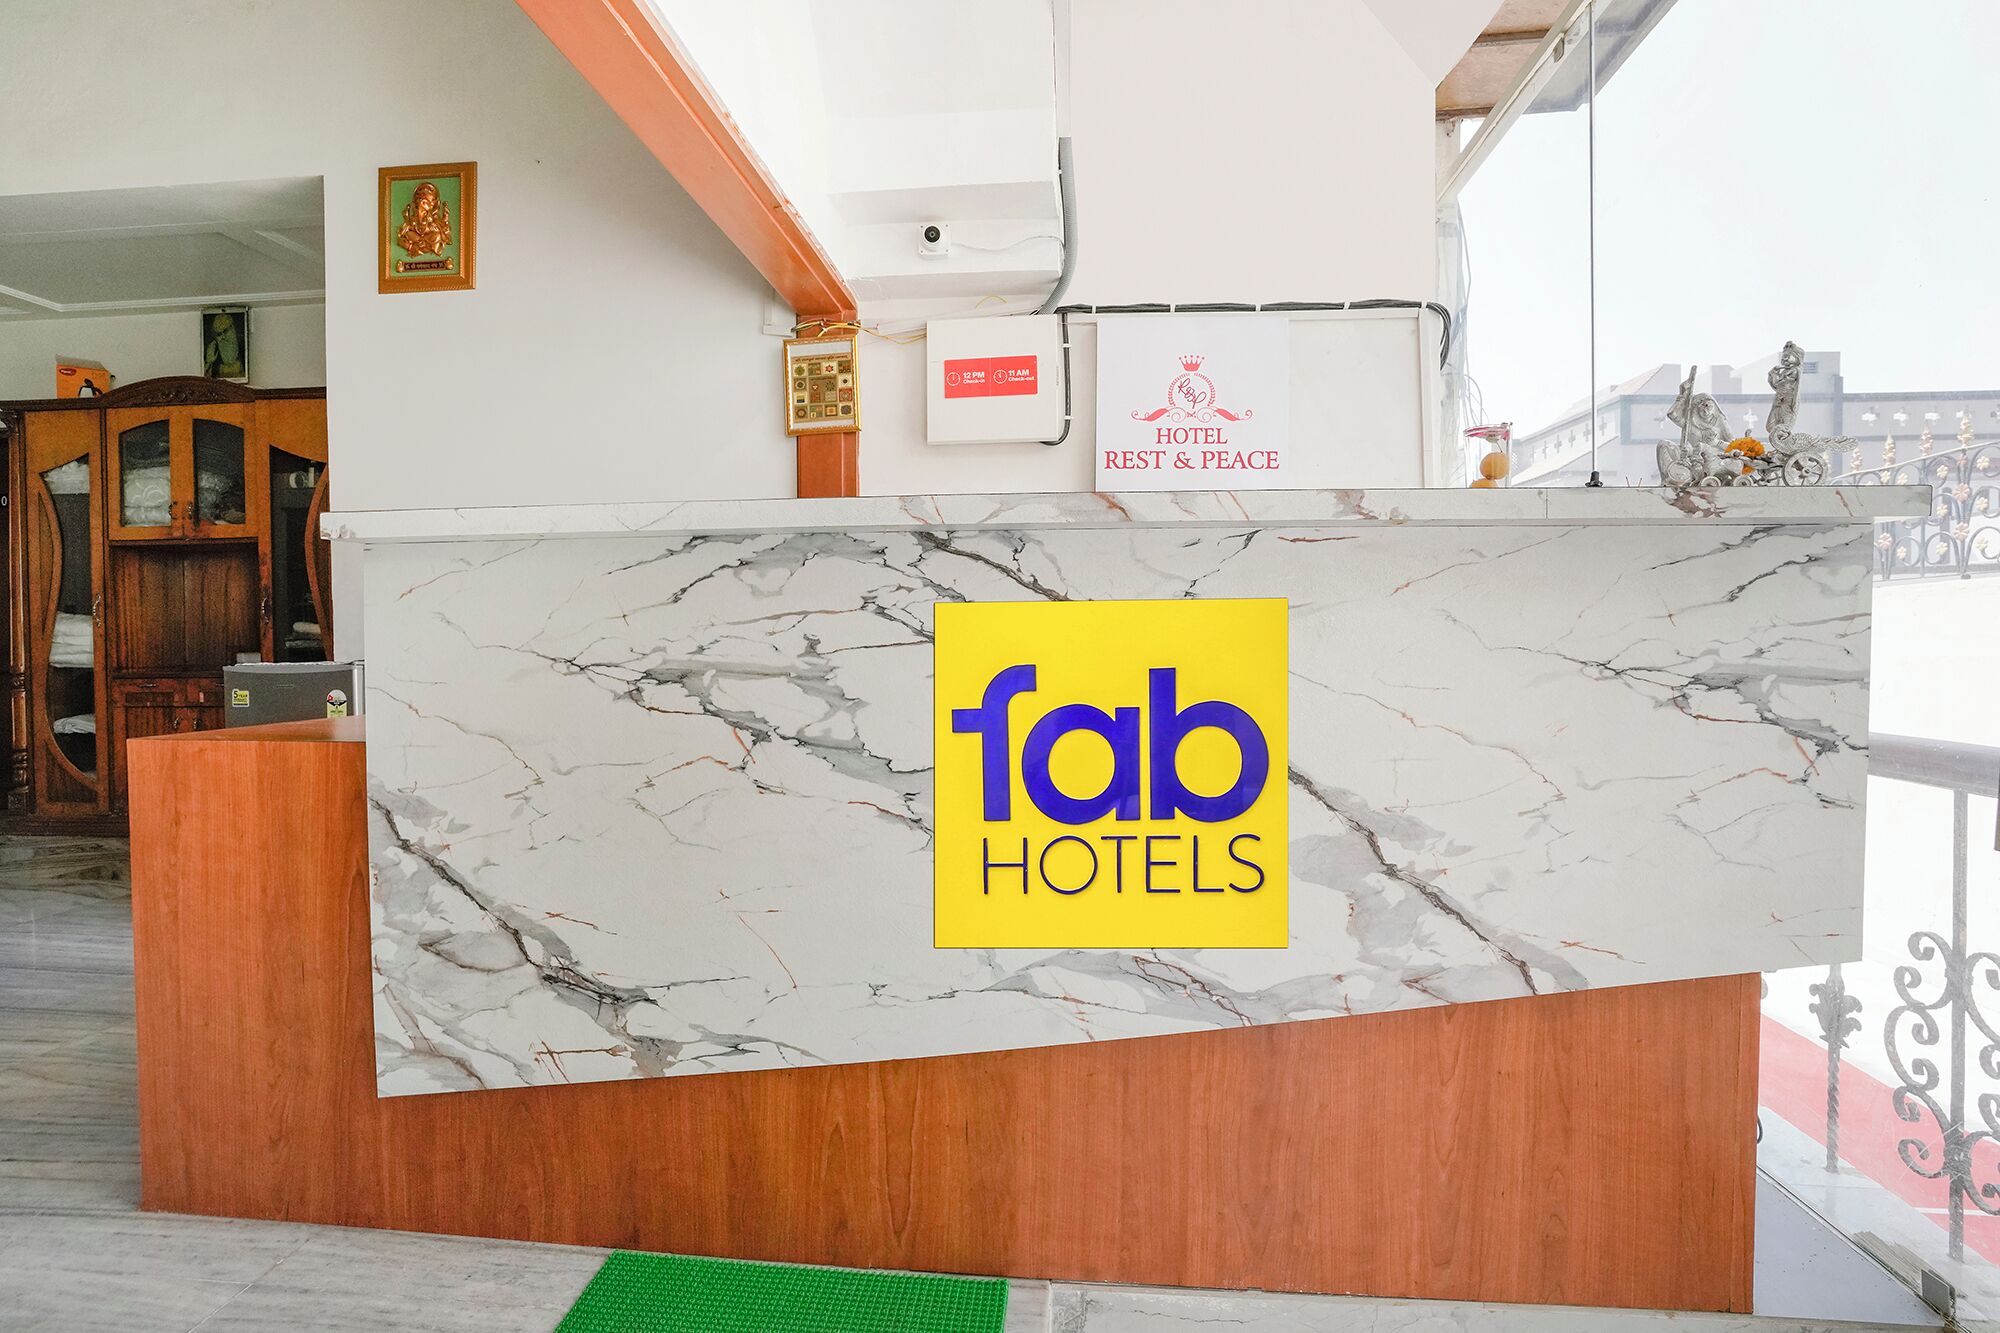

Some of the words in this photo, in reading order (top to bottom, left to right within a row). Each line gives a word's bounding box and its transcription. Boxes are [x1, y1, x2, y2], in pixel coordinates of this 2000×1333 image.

[1155, 427, 1228, 445] HOTEL
[1104, 450, 1166, 470] REST
[1173, 451, 1196, 470] &
[1201, 450, 1280, 470] PEACE
[951, 664, 1270, 825] fab
[982, 833, 1266, 896] HOTELS
